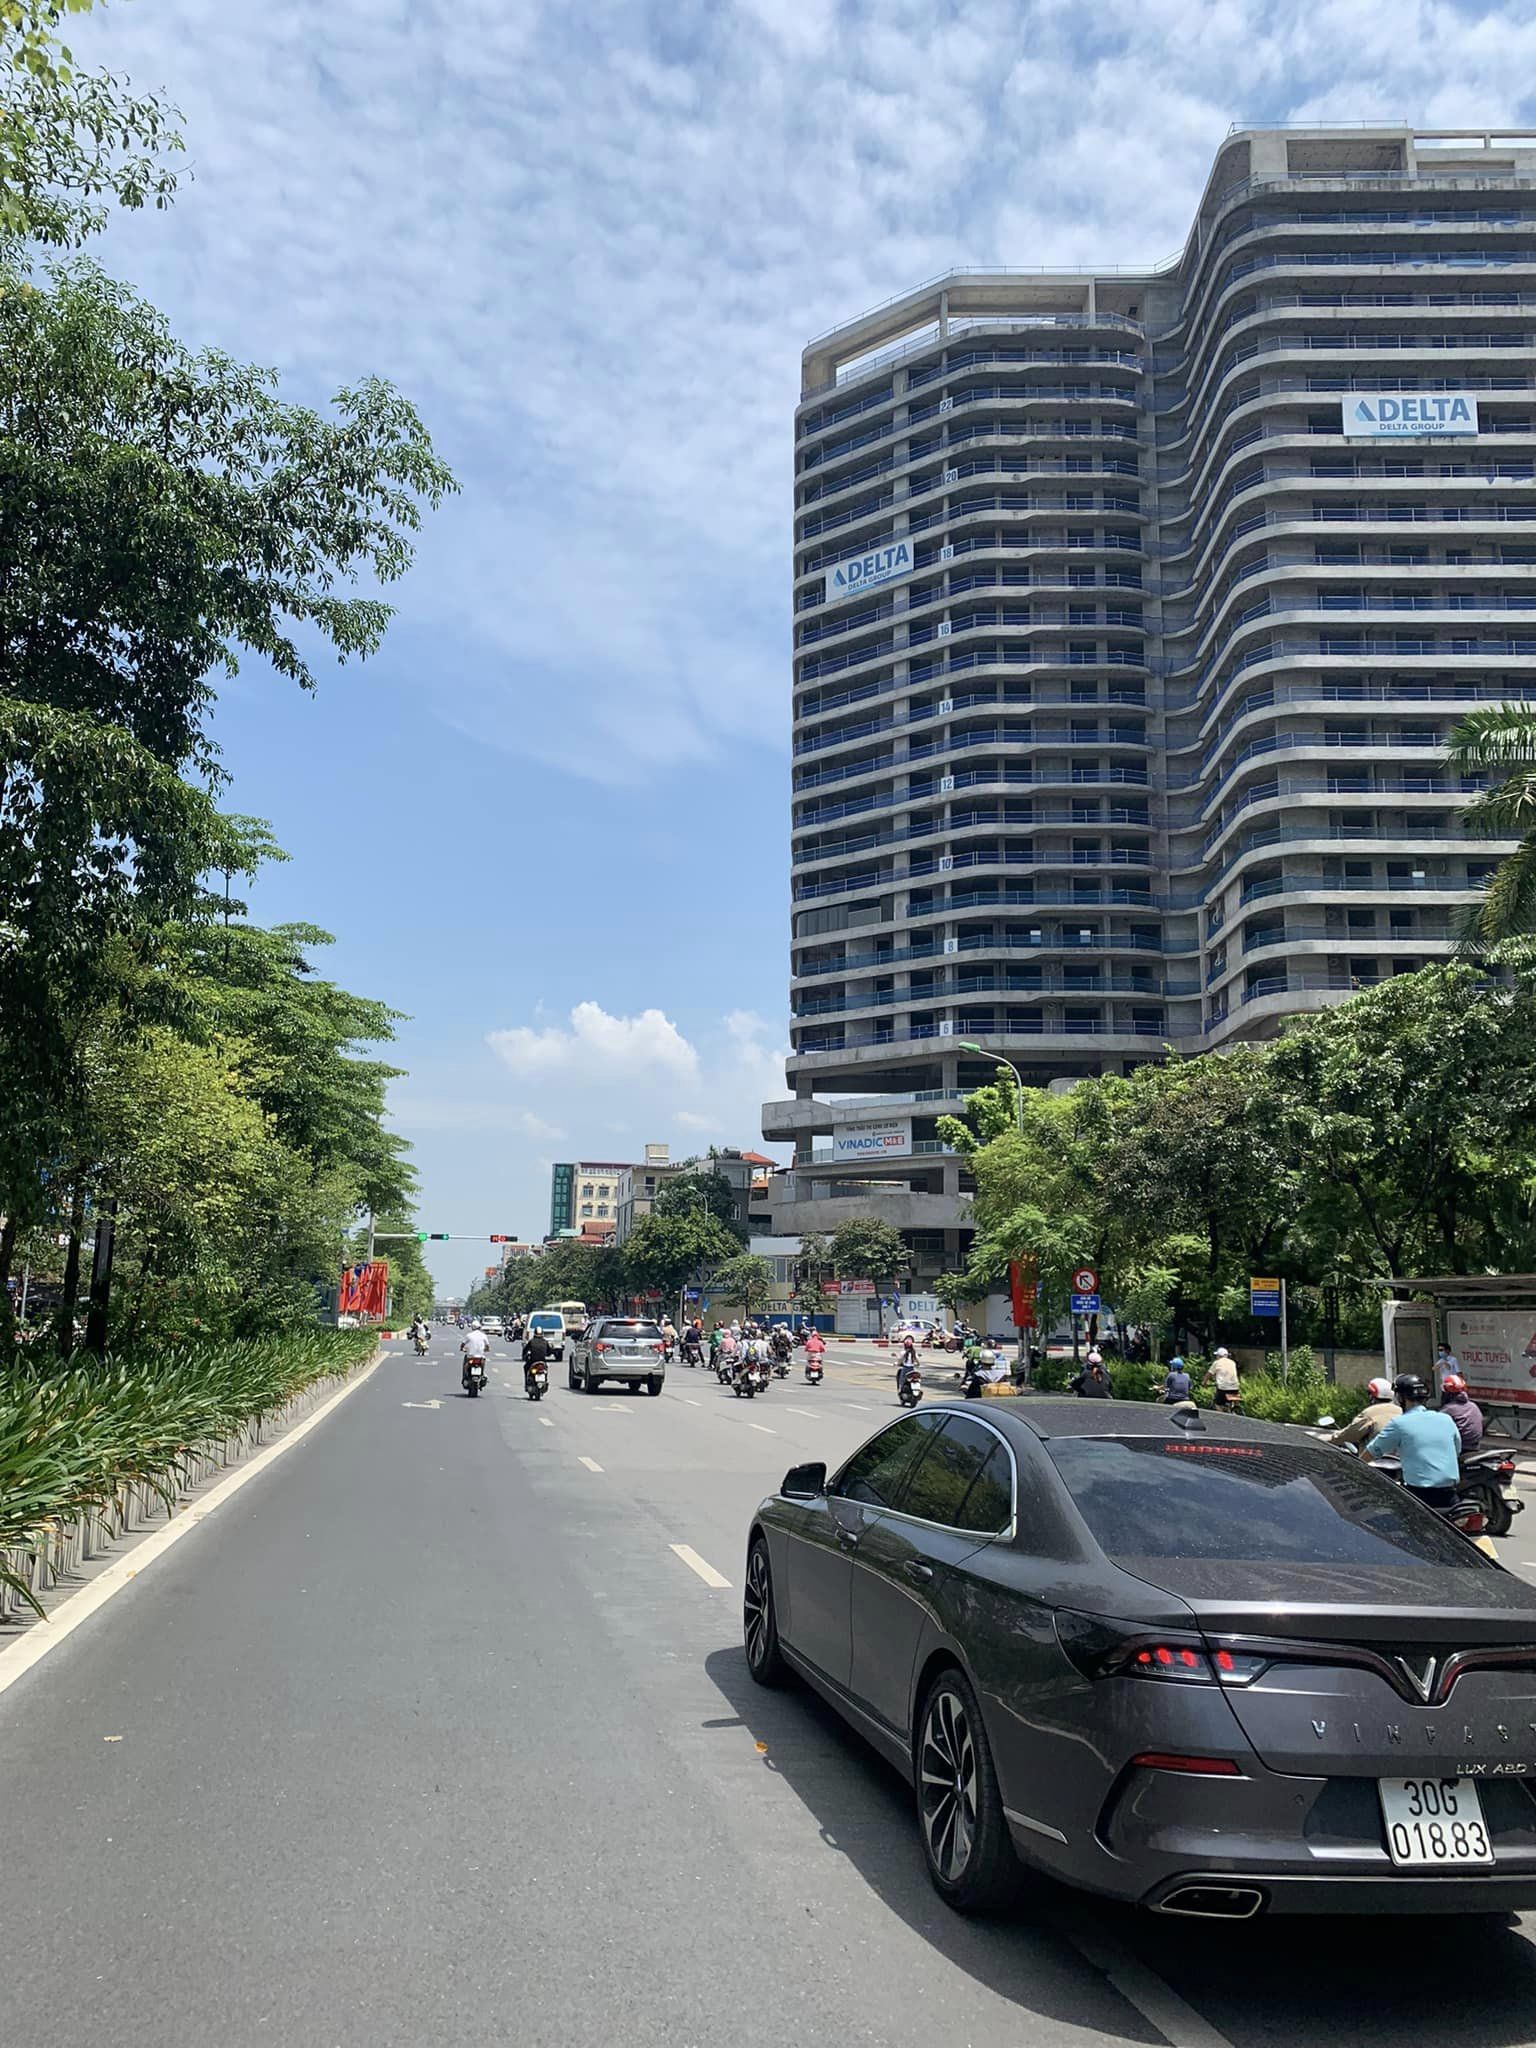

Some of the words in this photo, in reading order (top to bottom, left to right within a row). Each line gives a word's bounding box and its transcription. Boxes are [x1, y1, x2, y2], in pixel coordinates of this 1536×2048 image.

[941, 399, 952, 411] 22
[1378, 398, 1471, 421] DELTA
[946, 471, 956, 483] 20
[943, 547, 952, 559] 18
[848, 544, 909, 583] DELTA
[848, 579, 867, 590] DELTA
[940, 624, 950, 635] 16
[942, 701, 951, 713] 14
[943, 778, 952, 790] 12
[942, 859, 951, 870] 10
[838, 1137, 882, 1150] VINADIC
[761, 1302, 787, 1312] DELTA
[1456, 1764, 1487, 1774] LUX
[1404, 1781, 1459, 1816] 30G
[1392, 1822, 1488, 1859] 018.83
